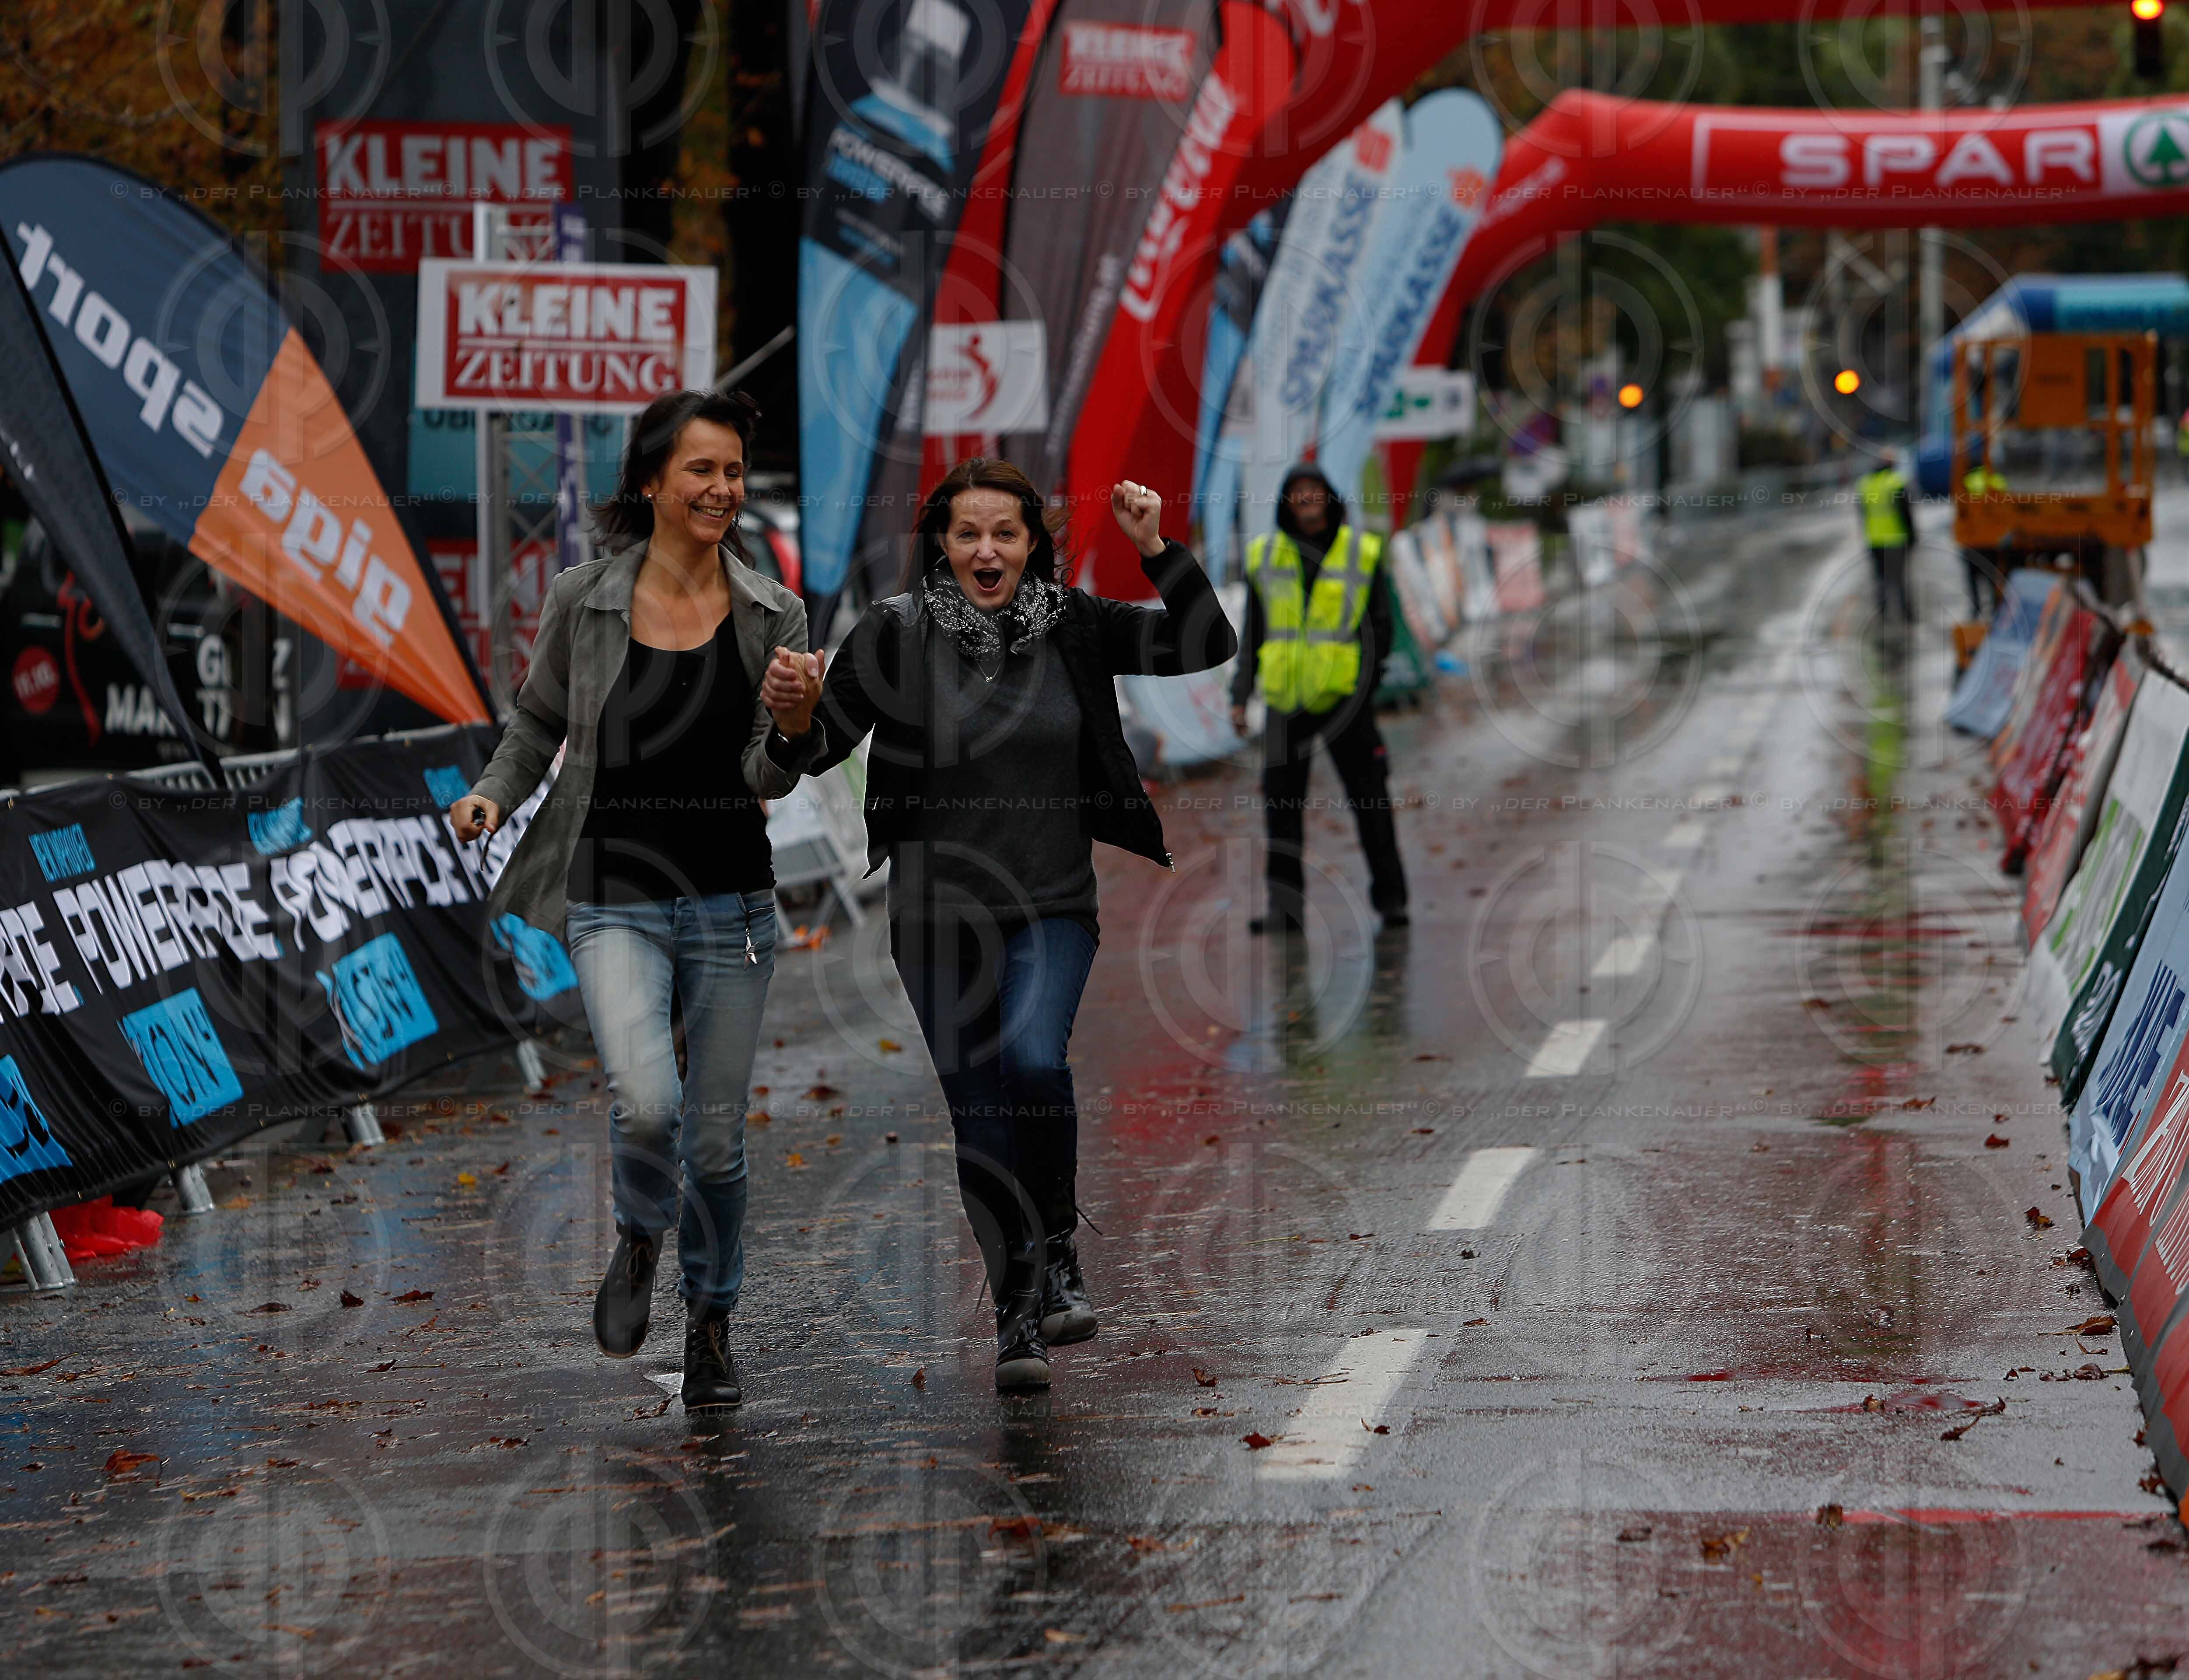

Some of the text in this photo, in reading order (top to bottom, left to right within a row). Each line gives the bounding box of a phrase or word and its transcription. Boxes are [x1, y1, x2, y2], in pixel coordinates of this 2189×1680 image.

[325, 133, 562, 200] KLEINE
[1779, 130, 2095, 188] SPAR
[458, 283, 676, 341] KLEINE
[455, 349, 675, 393] ZEITUNG
